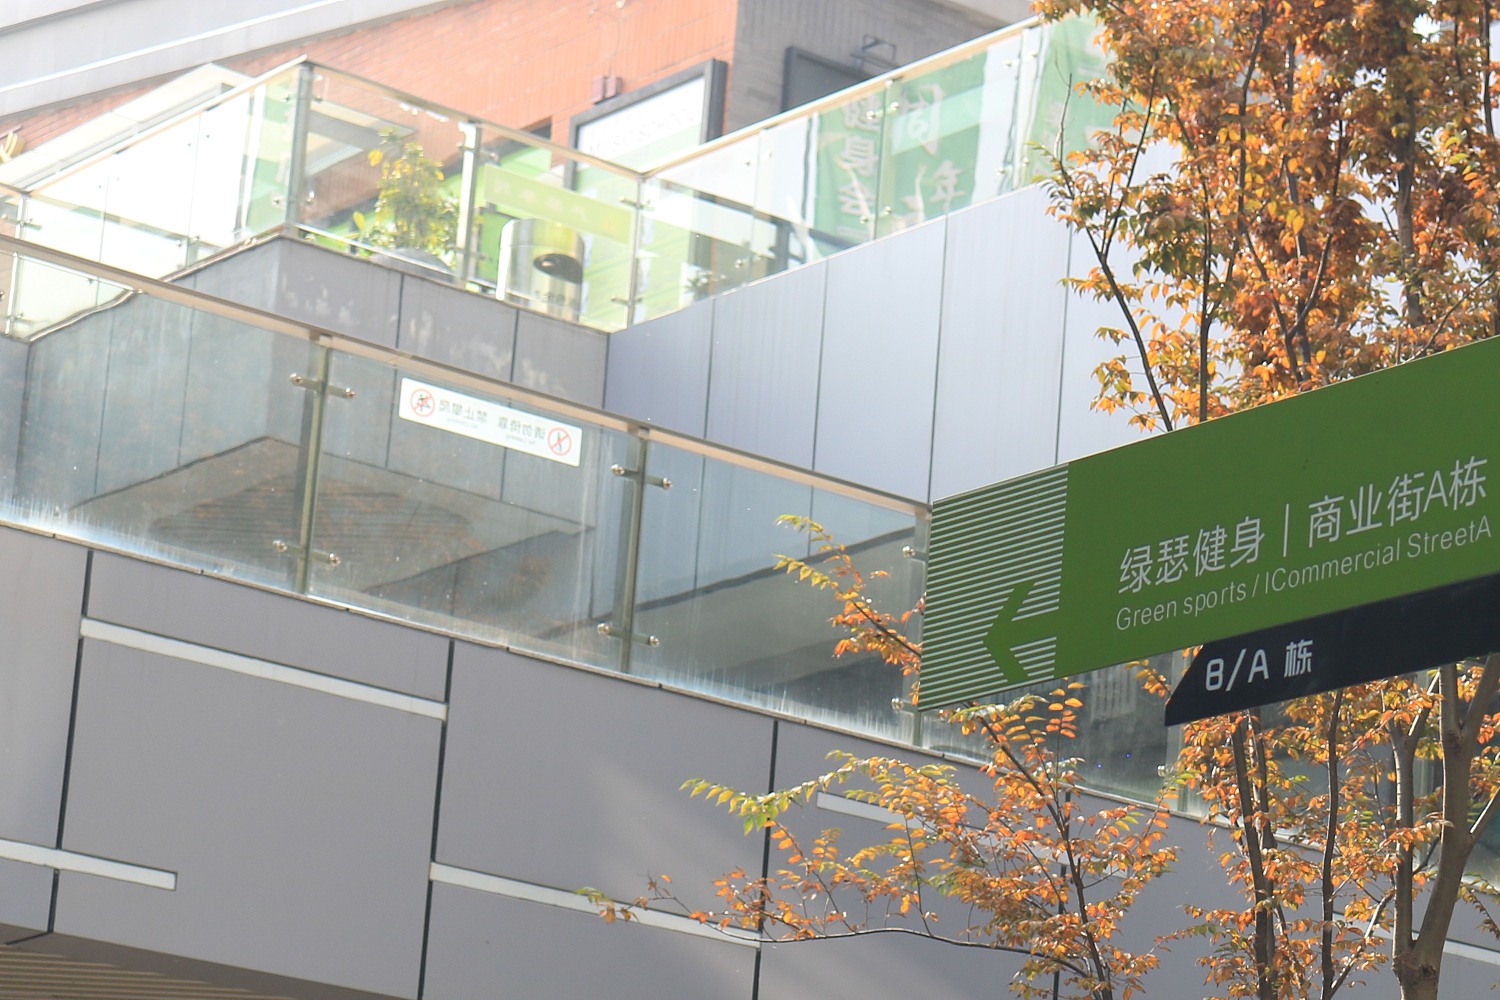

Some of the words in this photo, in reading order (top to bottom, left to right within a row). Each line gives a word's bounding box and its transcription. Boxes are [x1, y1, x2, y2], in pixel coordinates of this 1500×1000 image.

[1115, 598, 1177, 631] Green
[1182, 581, 1246, 619] sports
[1406, 514, 1492, 558] StreetA
[1117, 515, 1266, 595] 绿瑟健身
[1307, 455, 1489, 544] 商业街A栋
[1283, 638, 1313, 678] 栋
